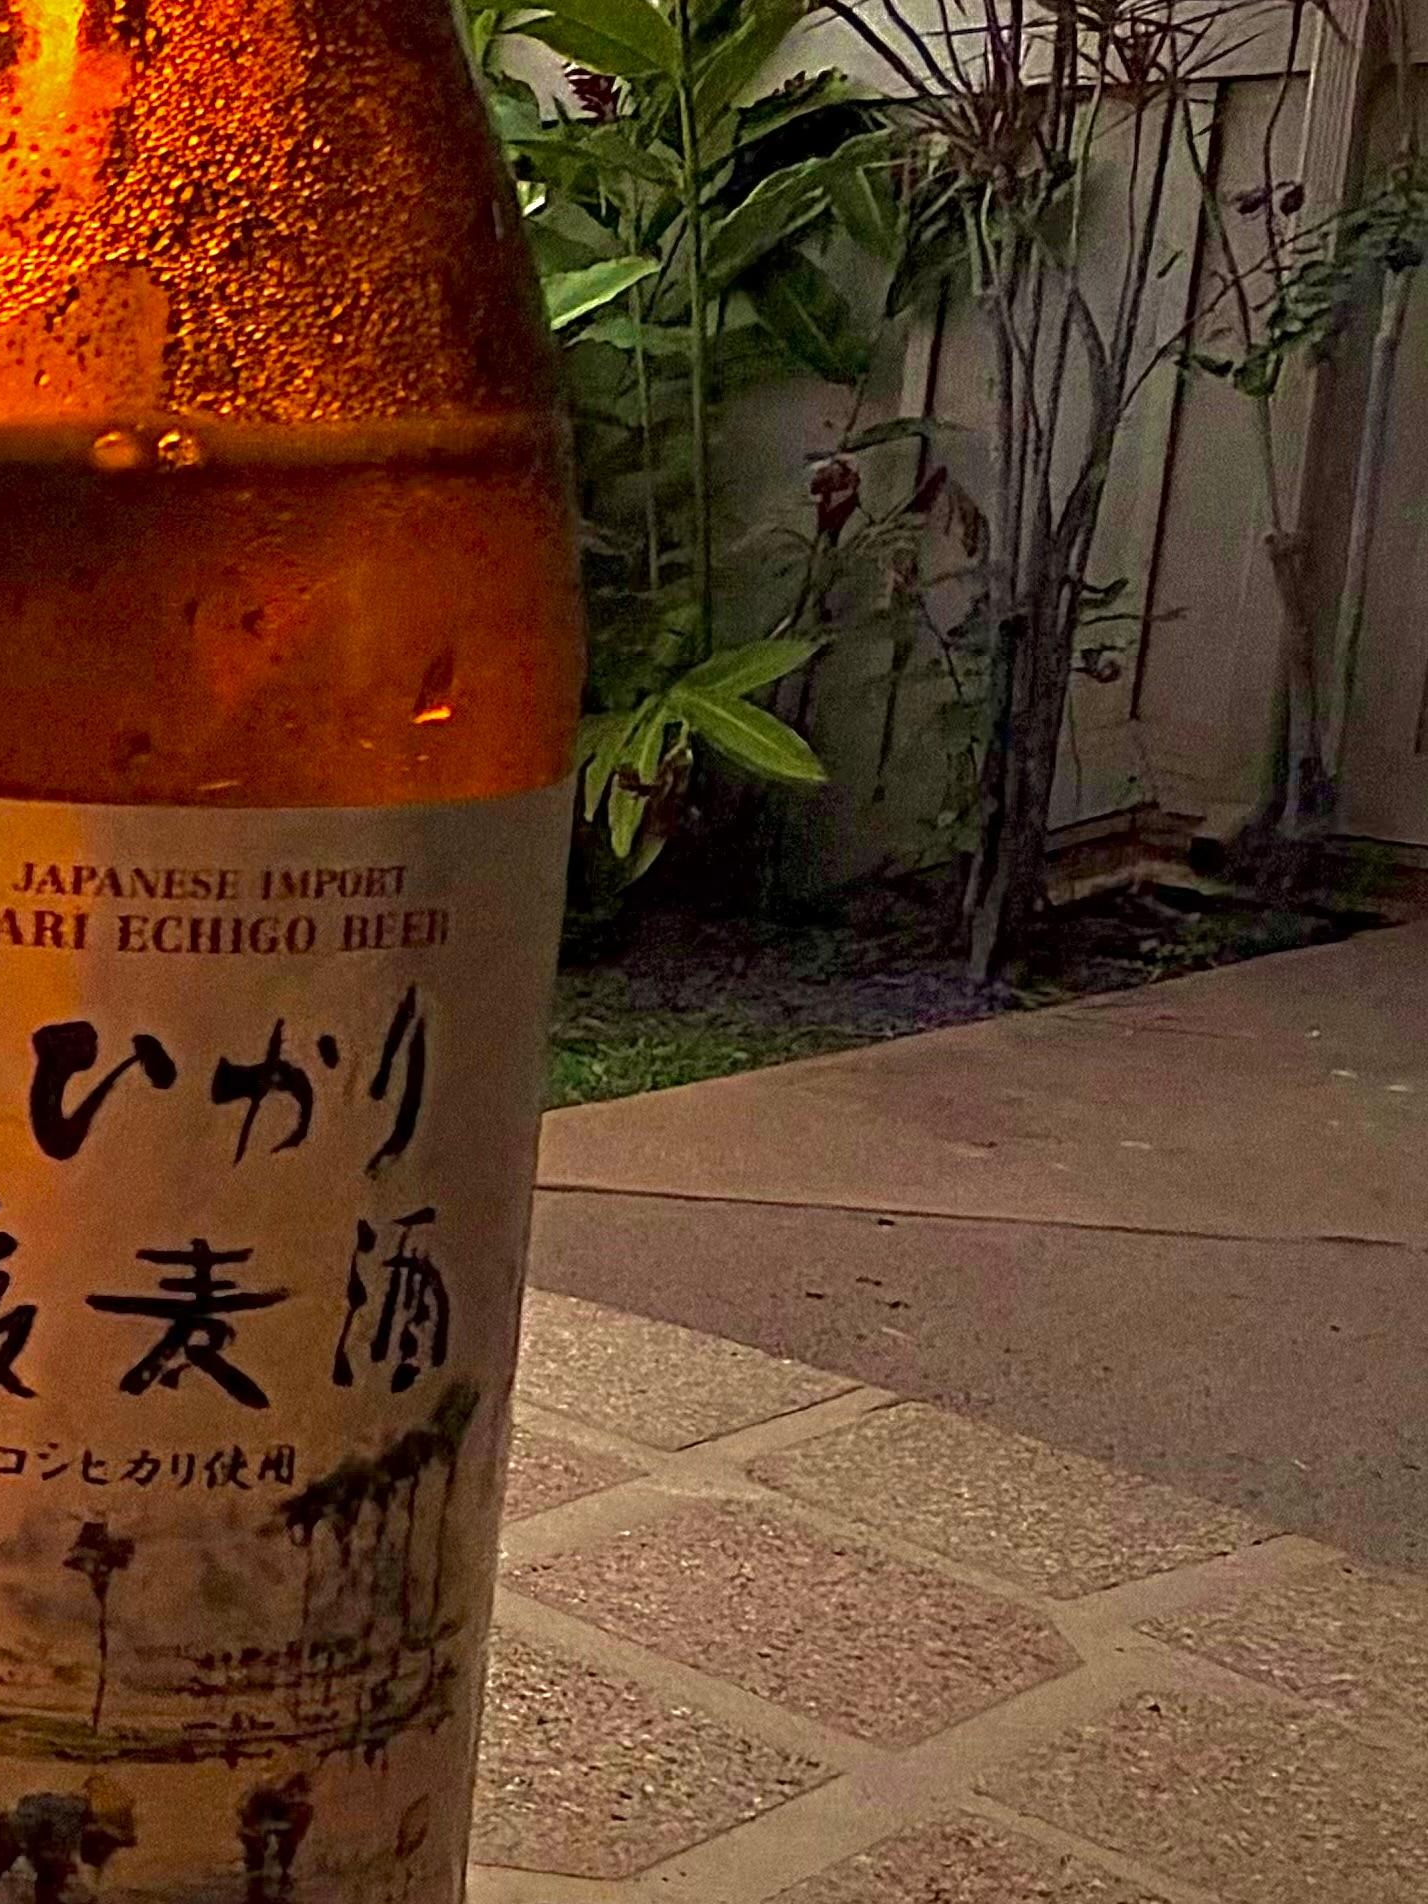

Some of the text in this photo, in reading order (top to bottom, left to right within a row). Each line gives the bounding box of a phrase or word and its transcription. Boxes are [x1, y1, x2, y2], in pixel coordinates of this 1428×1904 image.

[13, 861, 242, 901] JAPANESE
[260, 864, 407, 901] IMPORT
[117, 913, 318, 955] ECHIGO
[340, 907, 450, 953] BEER
